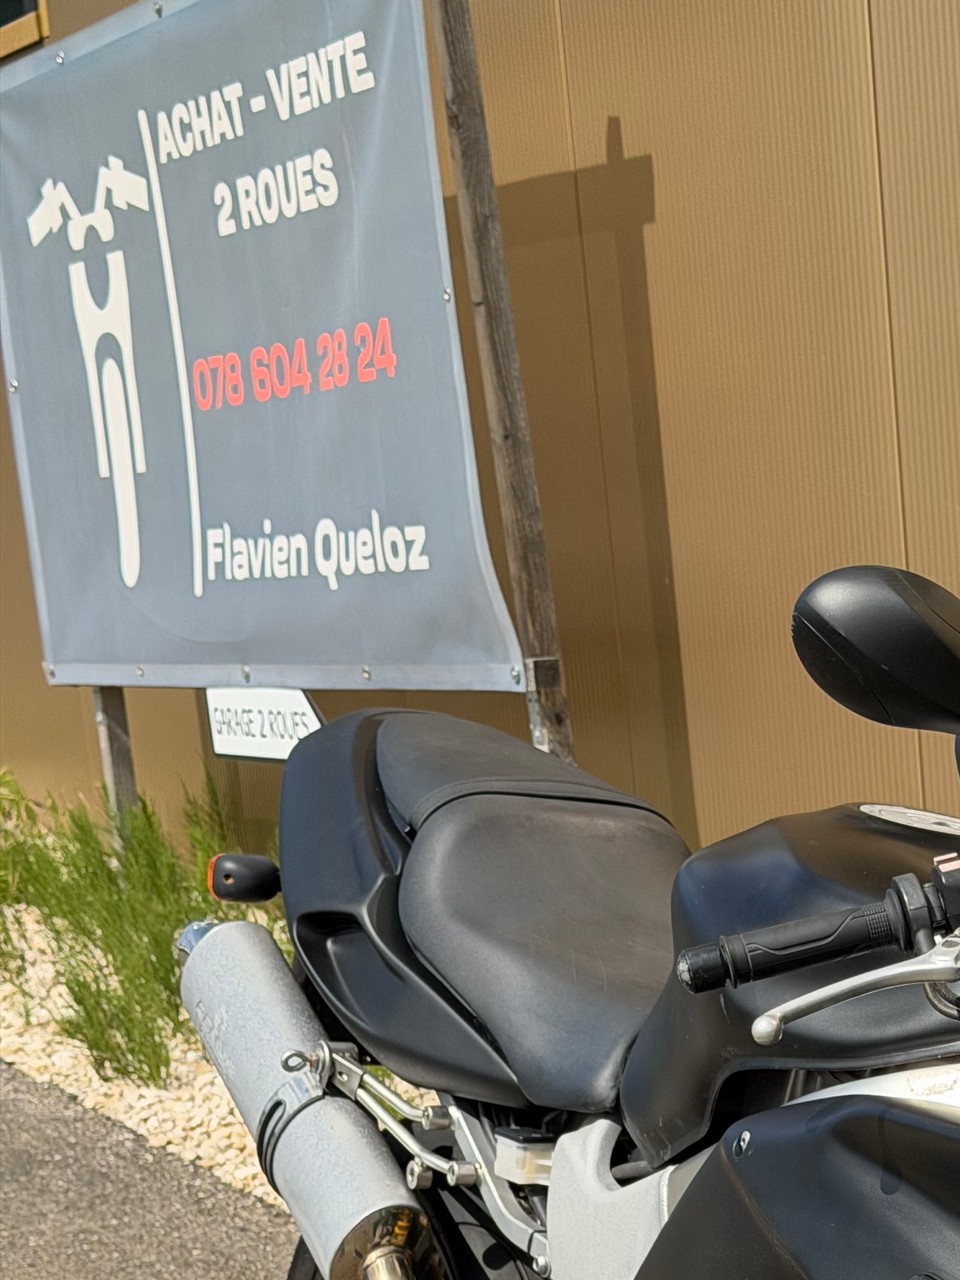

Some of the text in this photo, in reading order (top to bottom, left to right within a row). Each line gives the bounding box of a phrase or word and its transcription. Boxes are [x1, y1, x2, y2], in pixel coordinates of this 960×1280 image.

[157, 81, 244, 163] ACHAT
[265, 31, 376, 121] VENTE
[213, 149, 339, 237] 2 ROUES
[192, 317, 397, 411] 078 604 28 24
[206, 508, 430, 591] Flavien Queloz
[213, 707, 311, 739] GARAGE 2 ROUES
